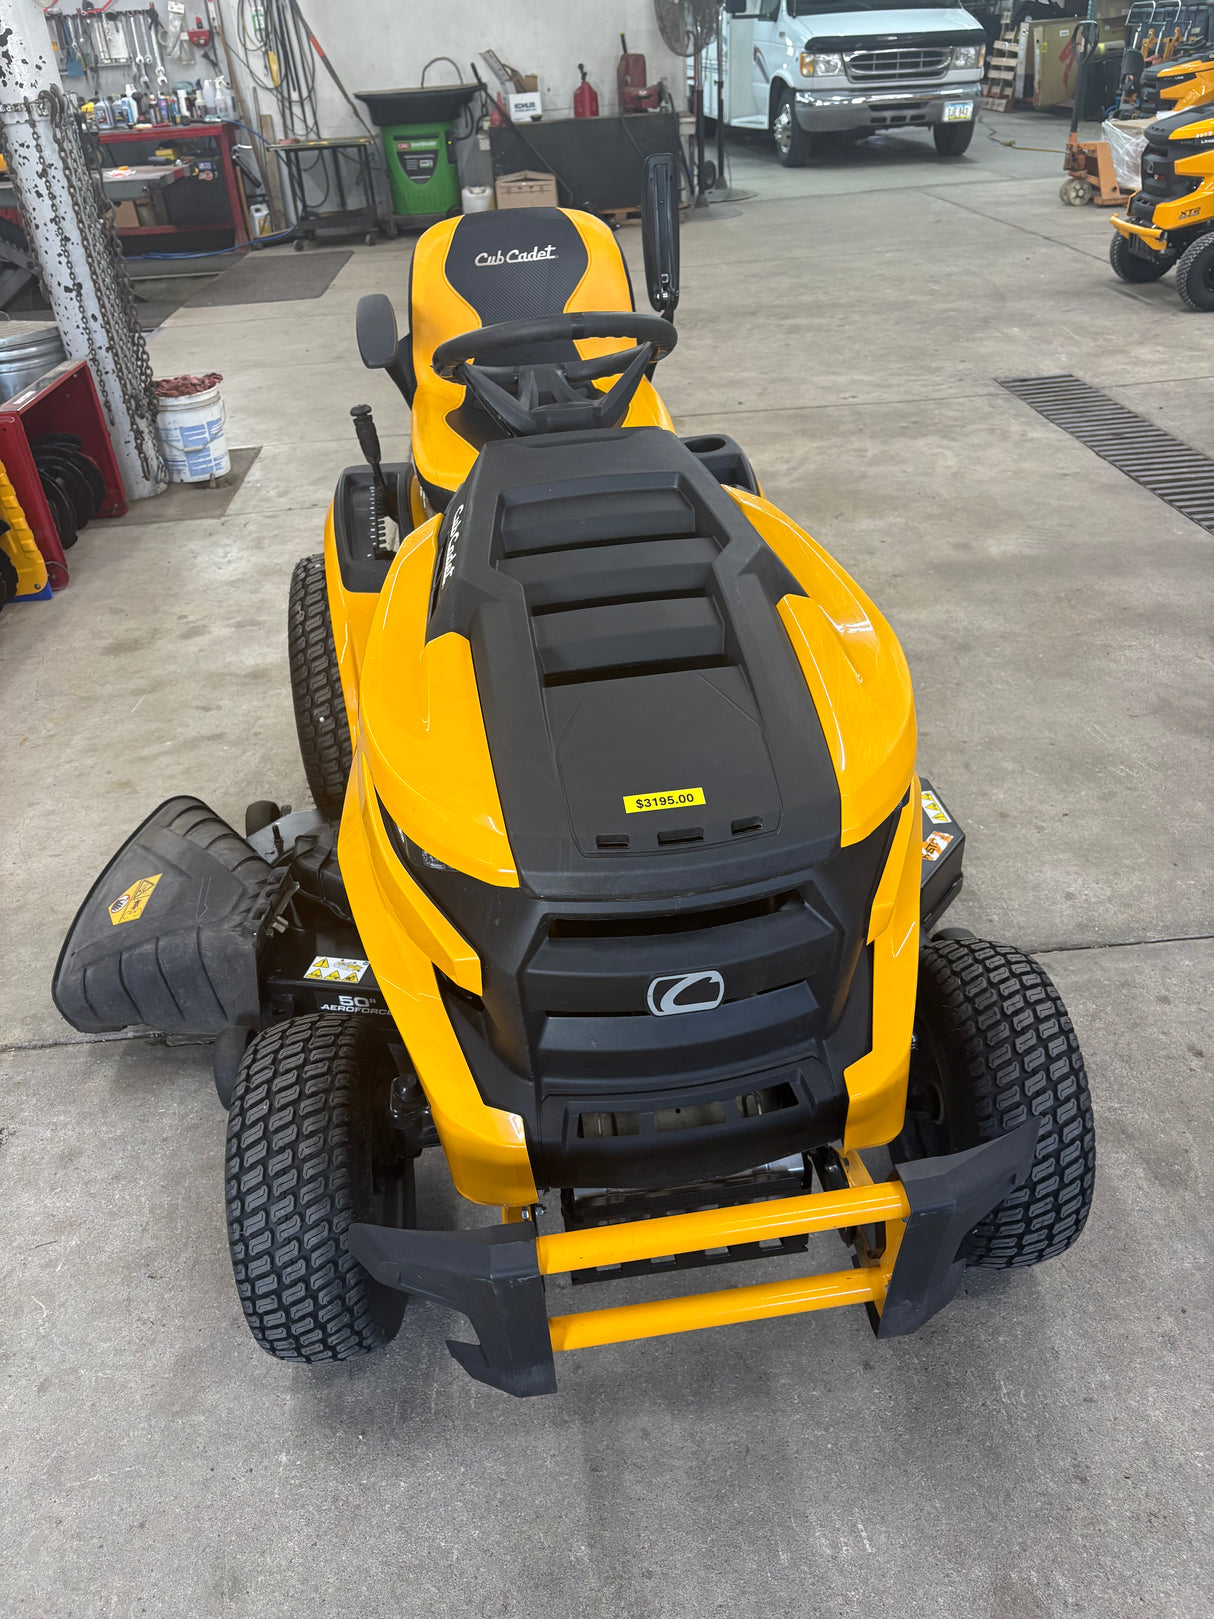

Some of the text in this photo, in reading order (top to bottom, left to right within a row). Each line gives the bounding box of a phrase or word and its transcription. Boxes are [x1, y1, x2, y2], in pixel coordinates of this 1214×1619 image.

[474, 244, 556, 267] Cub Cadet
[442, 504, 464, 586] Cub Cadet
[635, 793, 694, 809] $3195.00
